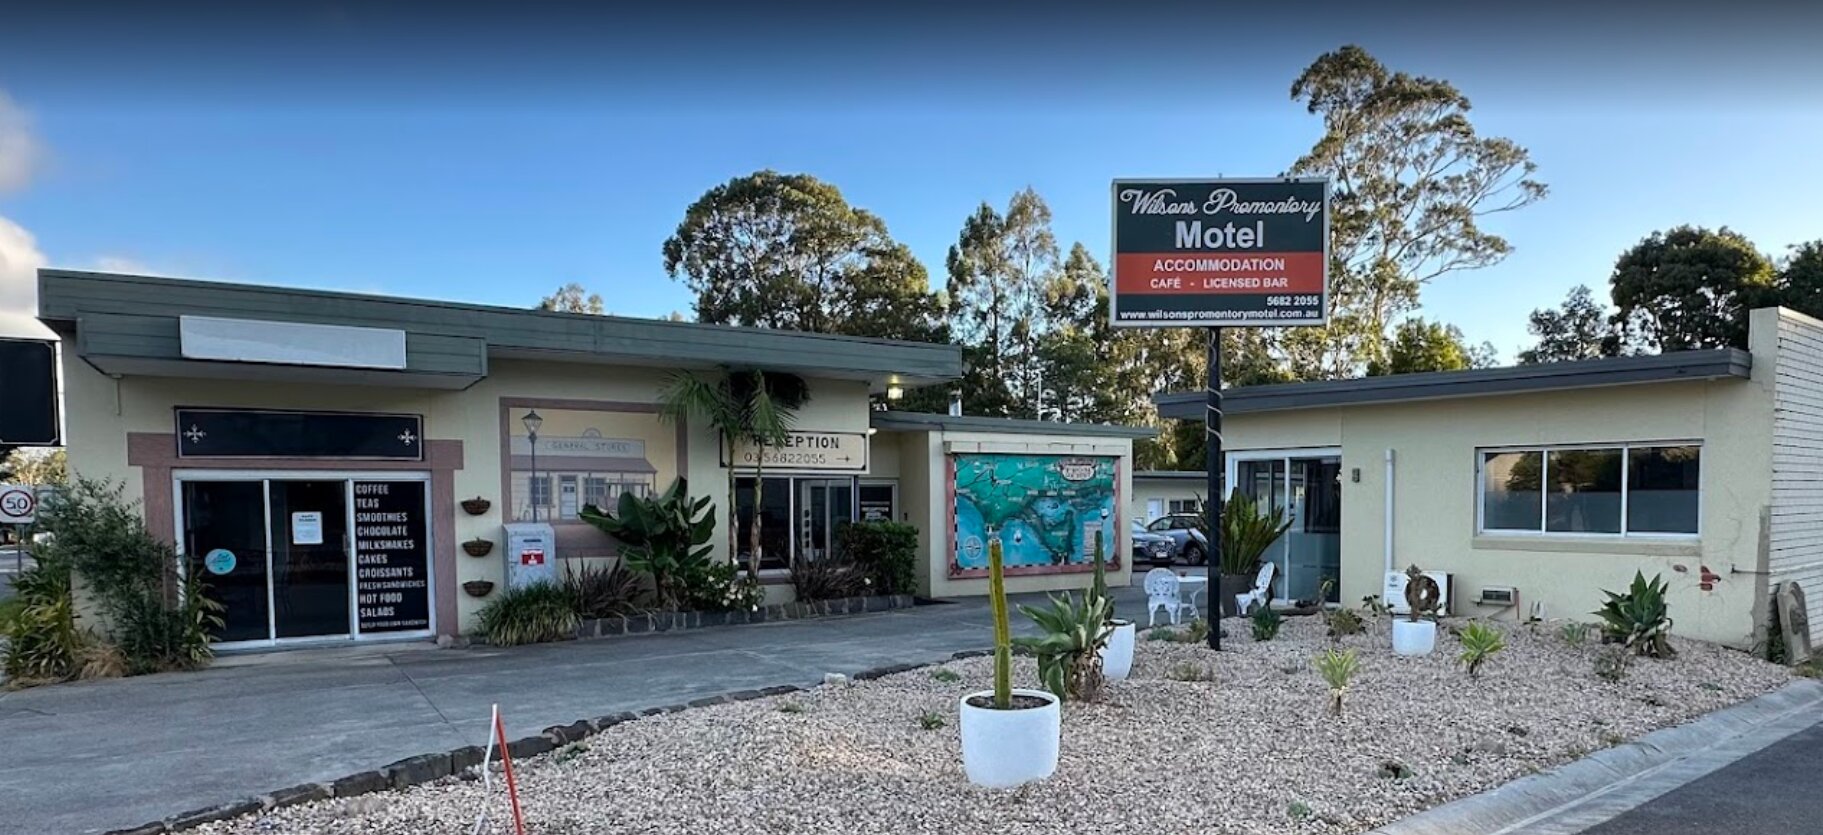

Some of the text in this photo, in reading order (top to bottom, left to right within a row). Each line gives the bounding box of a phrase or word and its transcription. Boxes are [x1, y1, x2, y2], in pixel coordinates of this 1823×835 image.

[1120, 188, 1321, 223] Wilsons Promontory
[1175, 220, 1264, 248] Motel
[1153, 258, 1285, 272] ACCOMMODATION
[1150, 276, 1181, 289] CAFÉ
[1203, 277, 1260, 289] LICENSED
[1263, 277, 1288, 288] BAR
[1266, 294, 1319, 306] 5682 2055
[1120, 308, 1319, 320] www.wilsonspromontorymotel.com.au
[752, 434, 839, 449] REEPTION
[355, 484, 389, 494] COFFEE
[6, 497, 28, 509] 50
[356, 498, 379, 508] TEAS
[357, 512, 408, 522] SMOOTHIES
[357, 526, 408, 536] CHOCOLATE
[358, 539, 414, 549] MILKSHAKES
[358, 554, 388, 564] CAKES
[359, 567, 413, 577] CROISSANTS
[360, 593, 402, 604] HOT FOOD
[360, 607, 394, 617] SALADS
